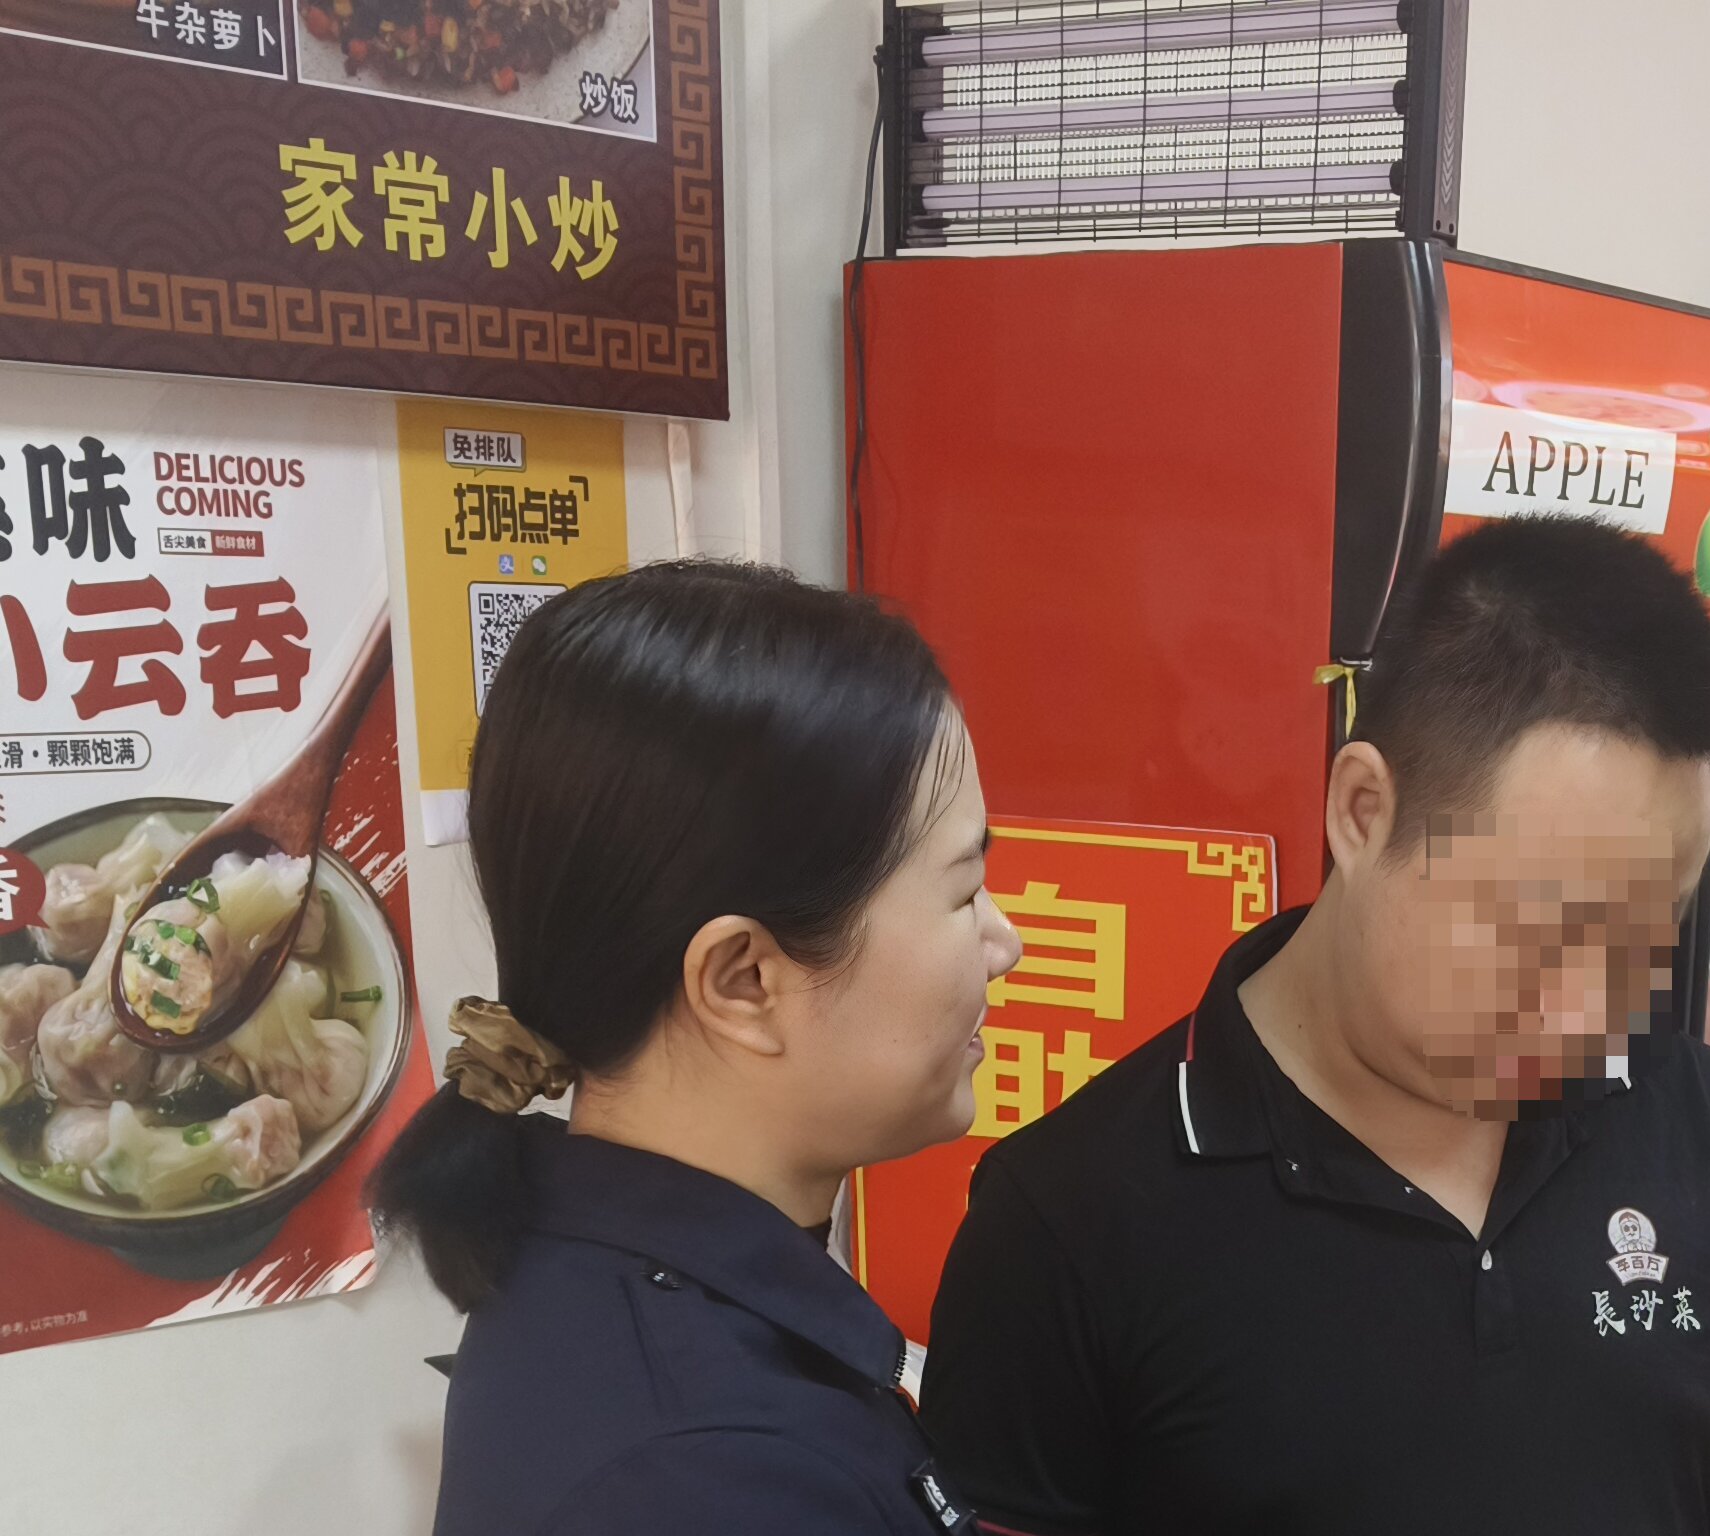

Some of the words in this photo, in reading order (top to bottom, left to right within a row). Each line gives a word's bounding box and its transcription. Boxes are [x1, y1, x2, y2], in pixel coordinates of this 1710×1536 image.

[136, 0, 276, 56] 牛杂萝卜
[579, 72, 638, 124] 炒饭
[278, 137, 619, 281] 家常小炒
[153, 451, 306, 488] DELICIOUS
[452, 432, 516, 463] 免排队
[1482, 431, 1650, 510] APPLE
[0, 435, 137, 563] 味
[156, 486, 273, 519] COMING
[453, 482, 580, 545] 扫码点单
[0, 574, 312, 721] 云吞
